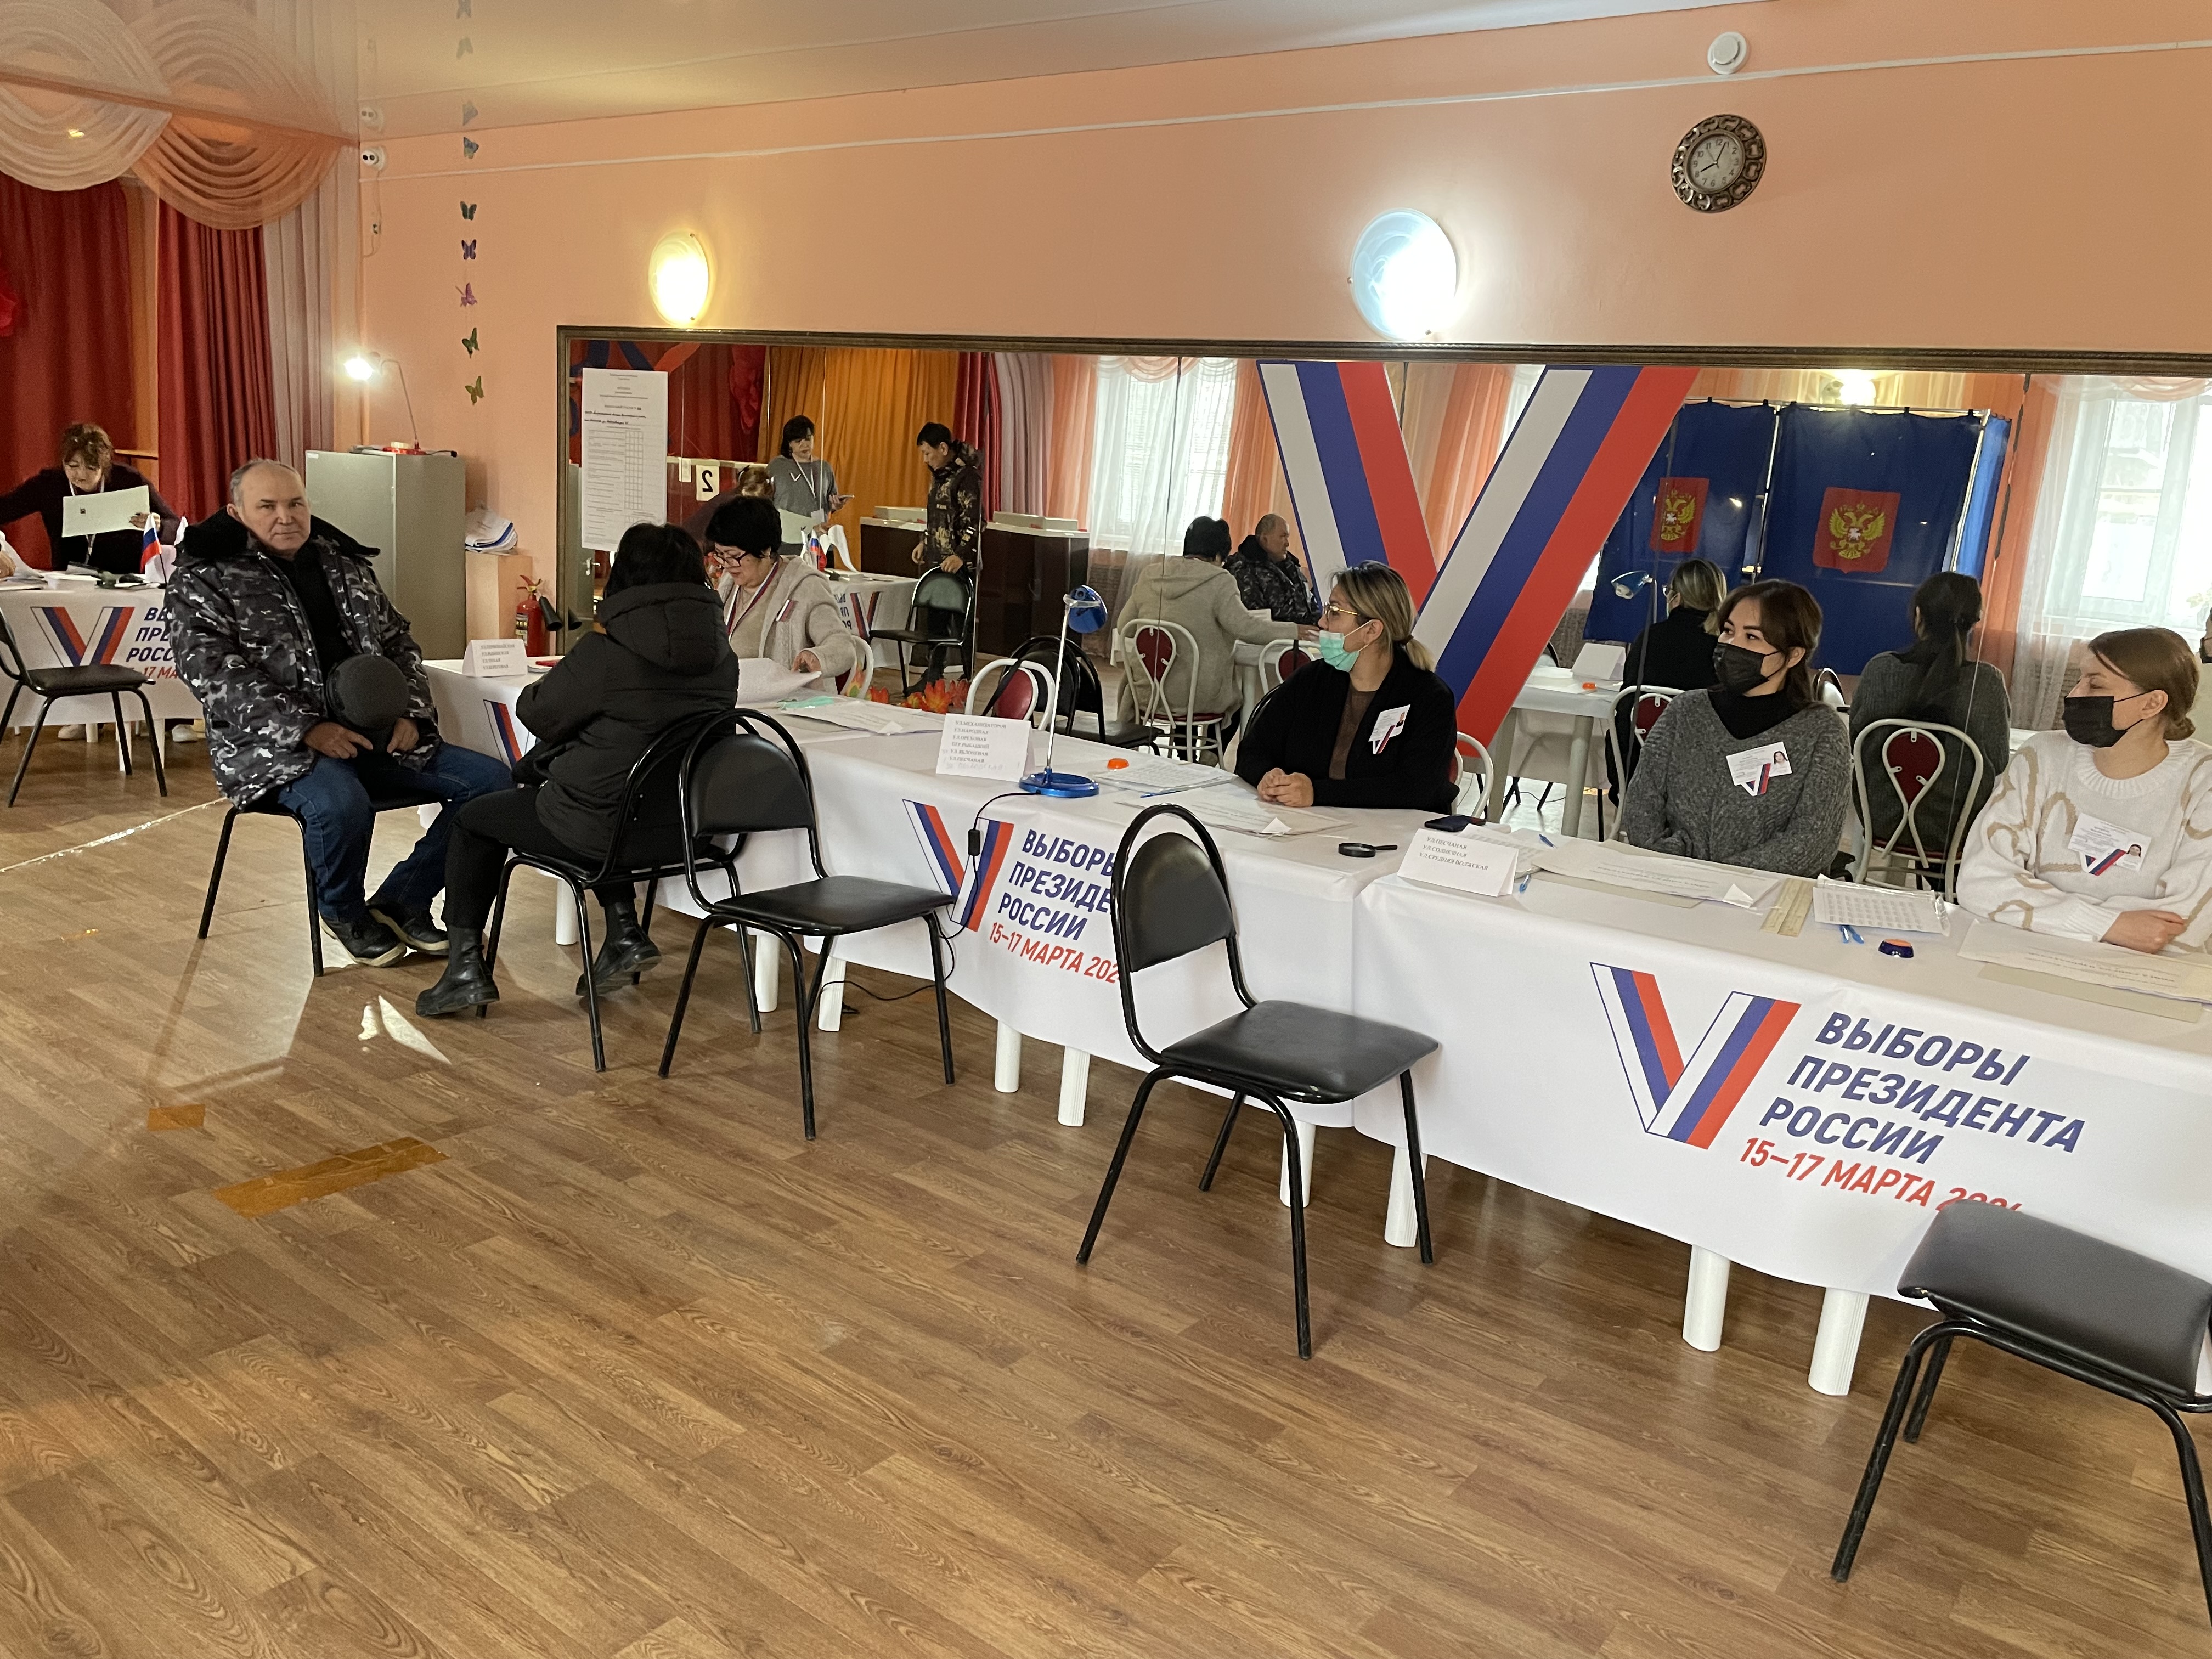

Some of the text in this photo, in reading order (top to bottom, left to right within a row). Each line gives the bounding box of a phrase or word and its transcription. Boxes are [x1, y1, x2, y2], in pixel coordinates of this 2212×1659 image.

[126, 647, 174, 662] РОСС
[1426, 837, 1467, 849] УЛ.ПЕСЧАНАЯ
[1008, 861, 1111, 913] ПРЕЗИДЕ
[998, 892, 1088, 940] РОССИИ
[1020, 938, 1084, 973] МАРТА
[1084, 956, 1119, 984] 202
[1815, 1011, 2031, 1086] ВЫБОРЫ
[1786, 1054, 2085, 1153] ПРЕЗИДЕНТА
[1759, 1097, 1945, 1164] РОССИИ
[1821, 1160, 1936, 1208] МАРТА
